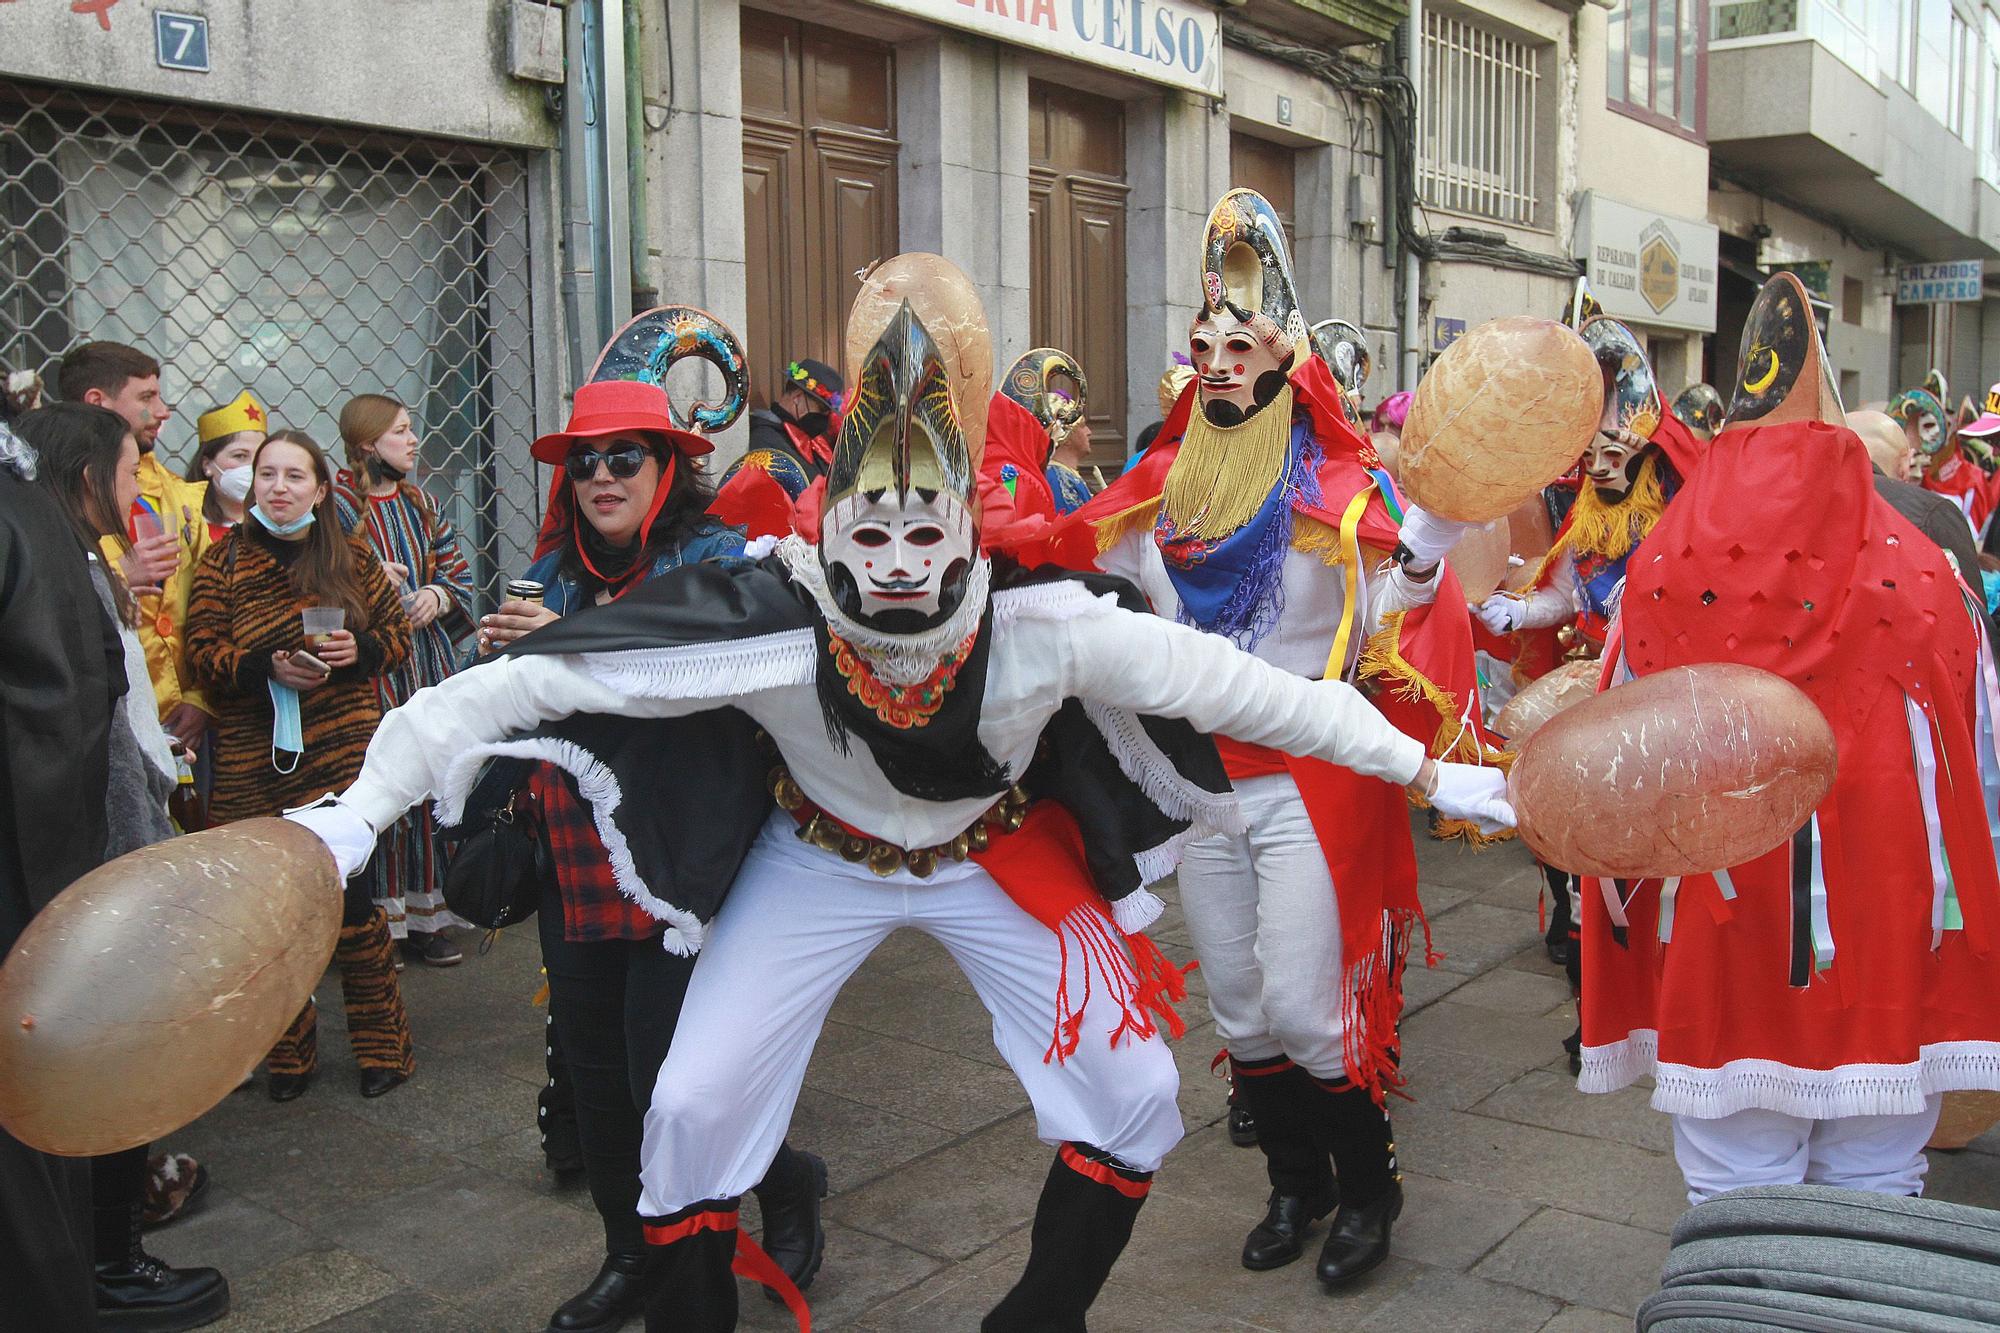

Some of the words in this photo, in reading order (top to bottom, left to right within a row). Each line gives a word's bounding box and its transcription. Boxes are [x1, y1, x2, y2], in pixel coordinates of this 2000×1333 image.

[169, 21, 195, 61] 7
[1071, 0, 1204, 74] CELSO
[1281, 99, 1290, 120] 9
[1597, 268, 1605, 286] DE
[1608, 271, 1636, 292] CALZADO
[1899, 263, 1979, 281] CALZADOS
[1900, 280, 1978, 300] CAMPERO
